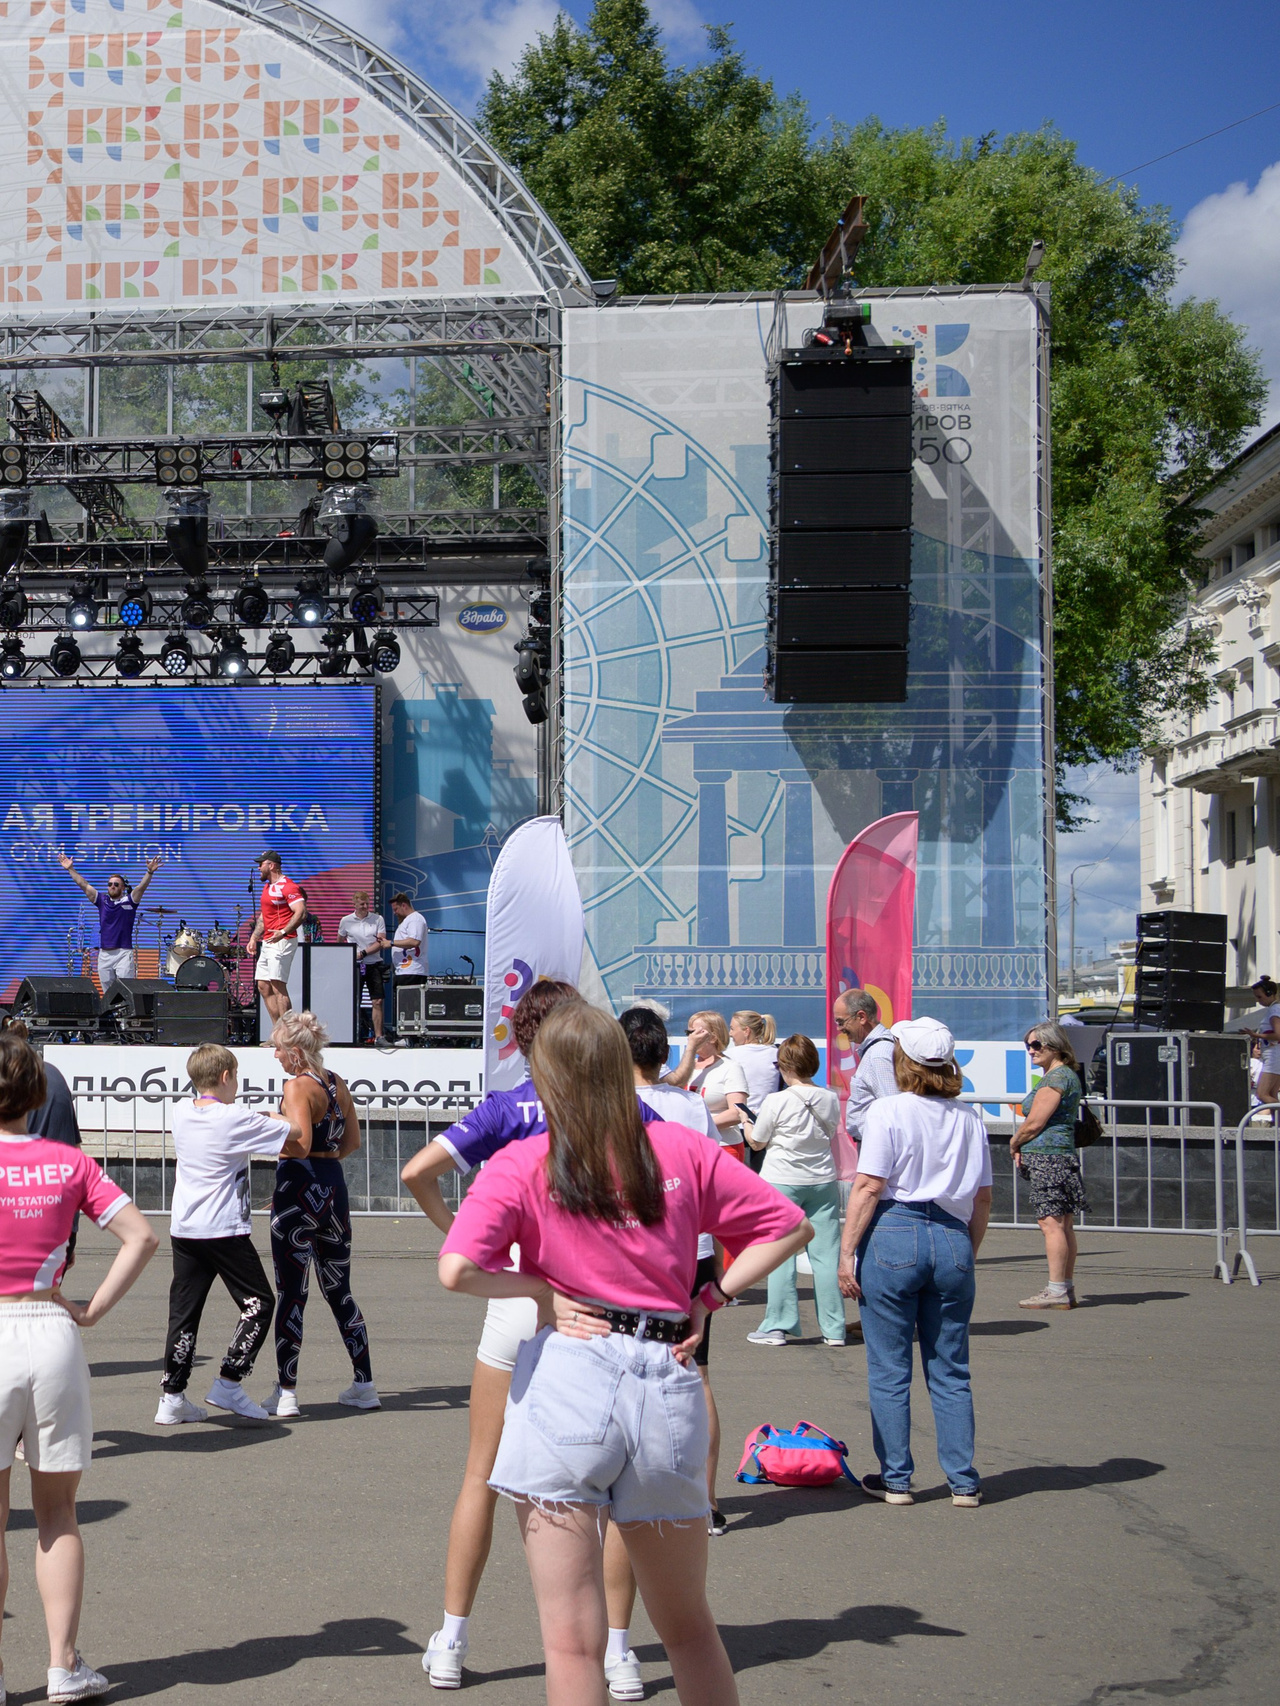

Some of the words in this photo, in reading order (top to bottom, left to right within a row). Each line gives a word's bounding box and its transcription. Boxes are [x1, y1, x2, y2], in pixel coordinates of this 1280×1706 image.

[911, 414, 972, 431] ИРОВ
[911, 436, 972, 465] 50
[461, 608, 504, 626] Здрава
[63, 803, 330, 832] ТРЕНИРОВКА
[10, 842, 66, 862] GYM
[74, 842, 182, 863] STATION
[17, 1194, 63, 1206] STATION
[12, 1208, 43, 1219] TEAM
